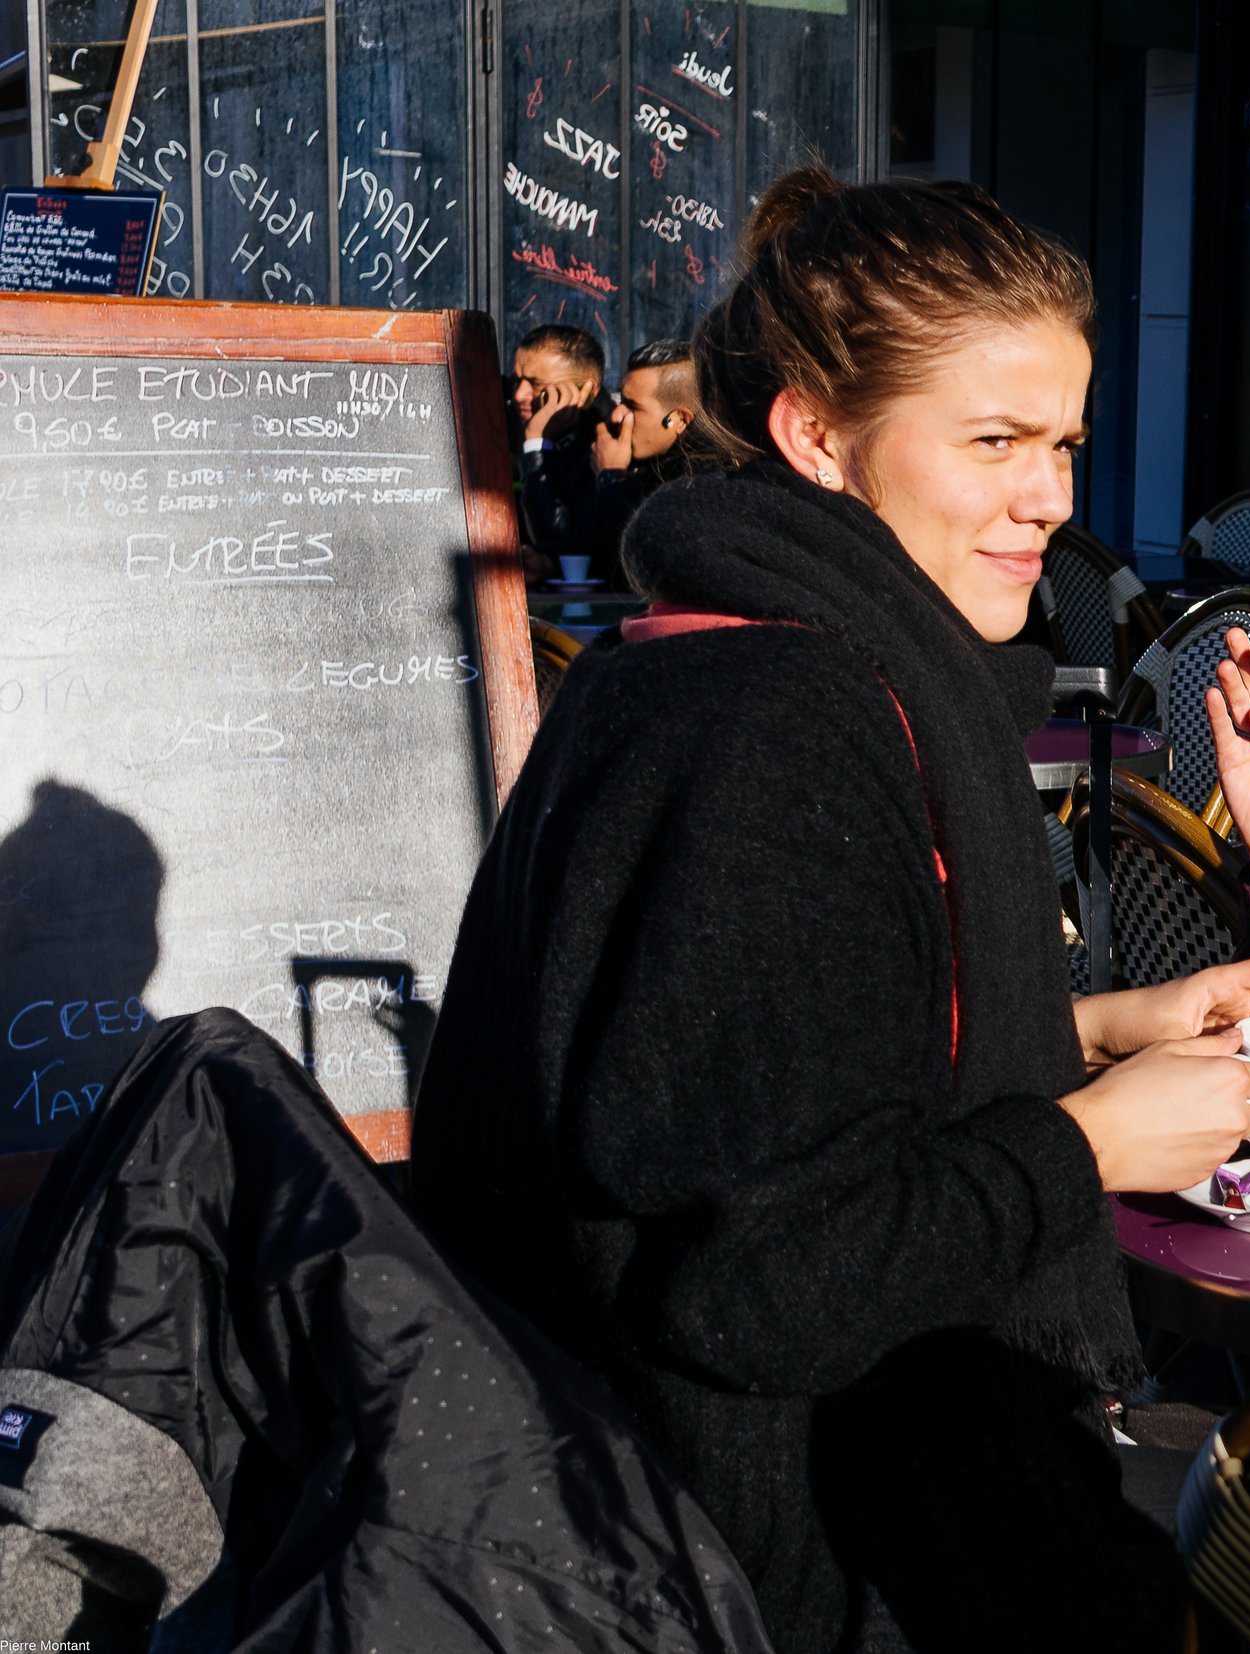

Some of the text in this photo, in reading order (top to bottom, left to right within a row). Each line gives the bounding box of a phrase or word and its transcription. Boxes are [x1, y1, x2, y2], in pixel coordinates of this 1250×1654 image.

[137, 366, 334, 402] ETUDIANT
[251, 413, 360, 439] BOISSON
[320, 466, 413, 486] DESSERT
[371, 488, 449, 505] DESSERT
[286, 655, 480, 691] LEGUMES
[238, 974, 438, 1021] CARAME
